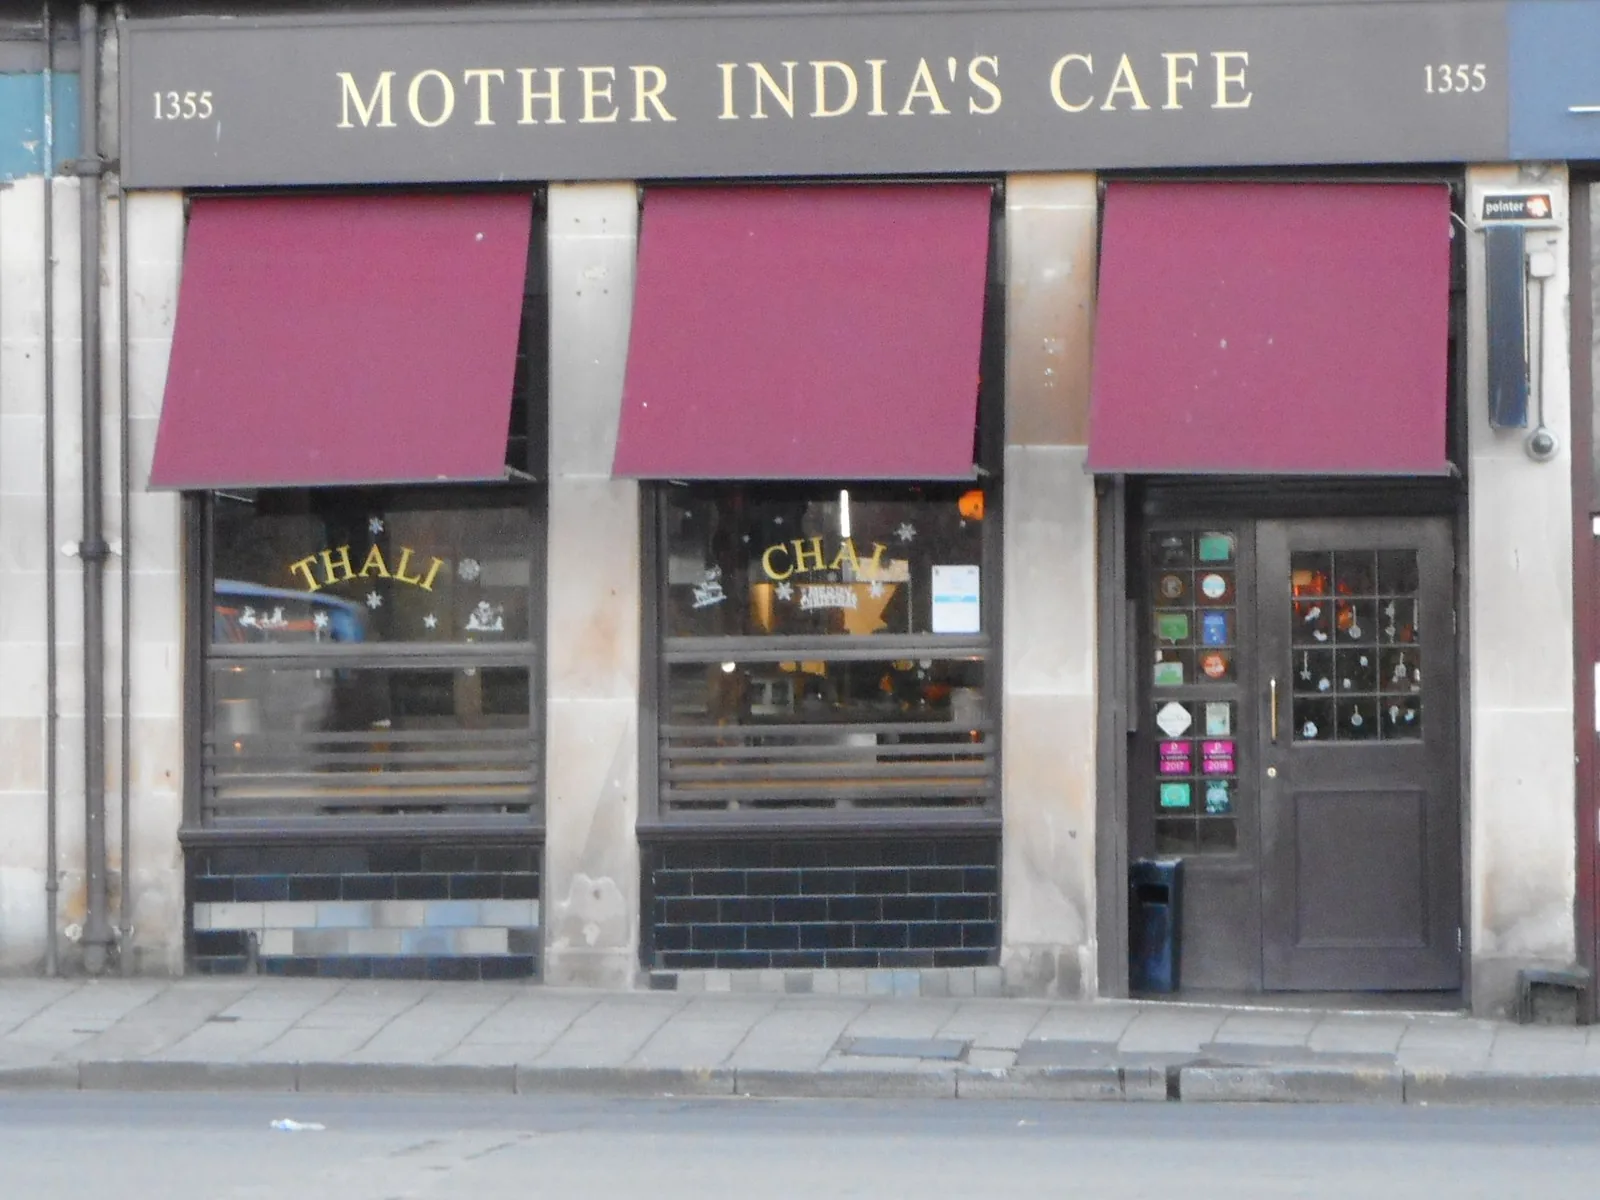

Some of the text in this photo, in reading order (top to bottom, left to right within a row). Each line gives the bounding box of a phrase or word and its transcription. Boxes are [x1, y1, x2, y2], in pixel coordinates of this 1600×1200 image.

[336, 49, 1253, 130] MOTHER INDIA'S CAFE
[1423, 62, 1488, 95] 1355
[152, 89, 213, 120] 1355
[1486, 201, 1524, 215] pointer
[289, 543, 444, 592] THALI
[762, 536, 888, 580] CHAI
